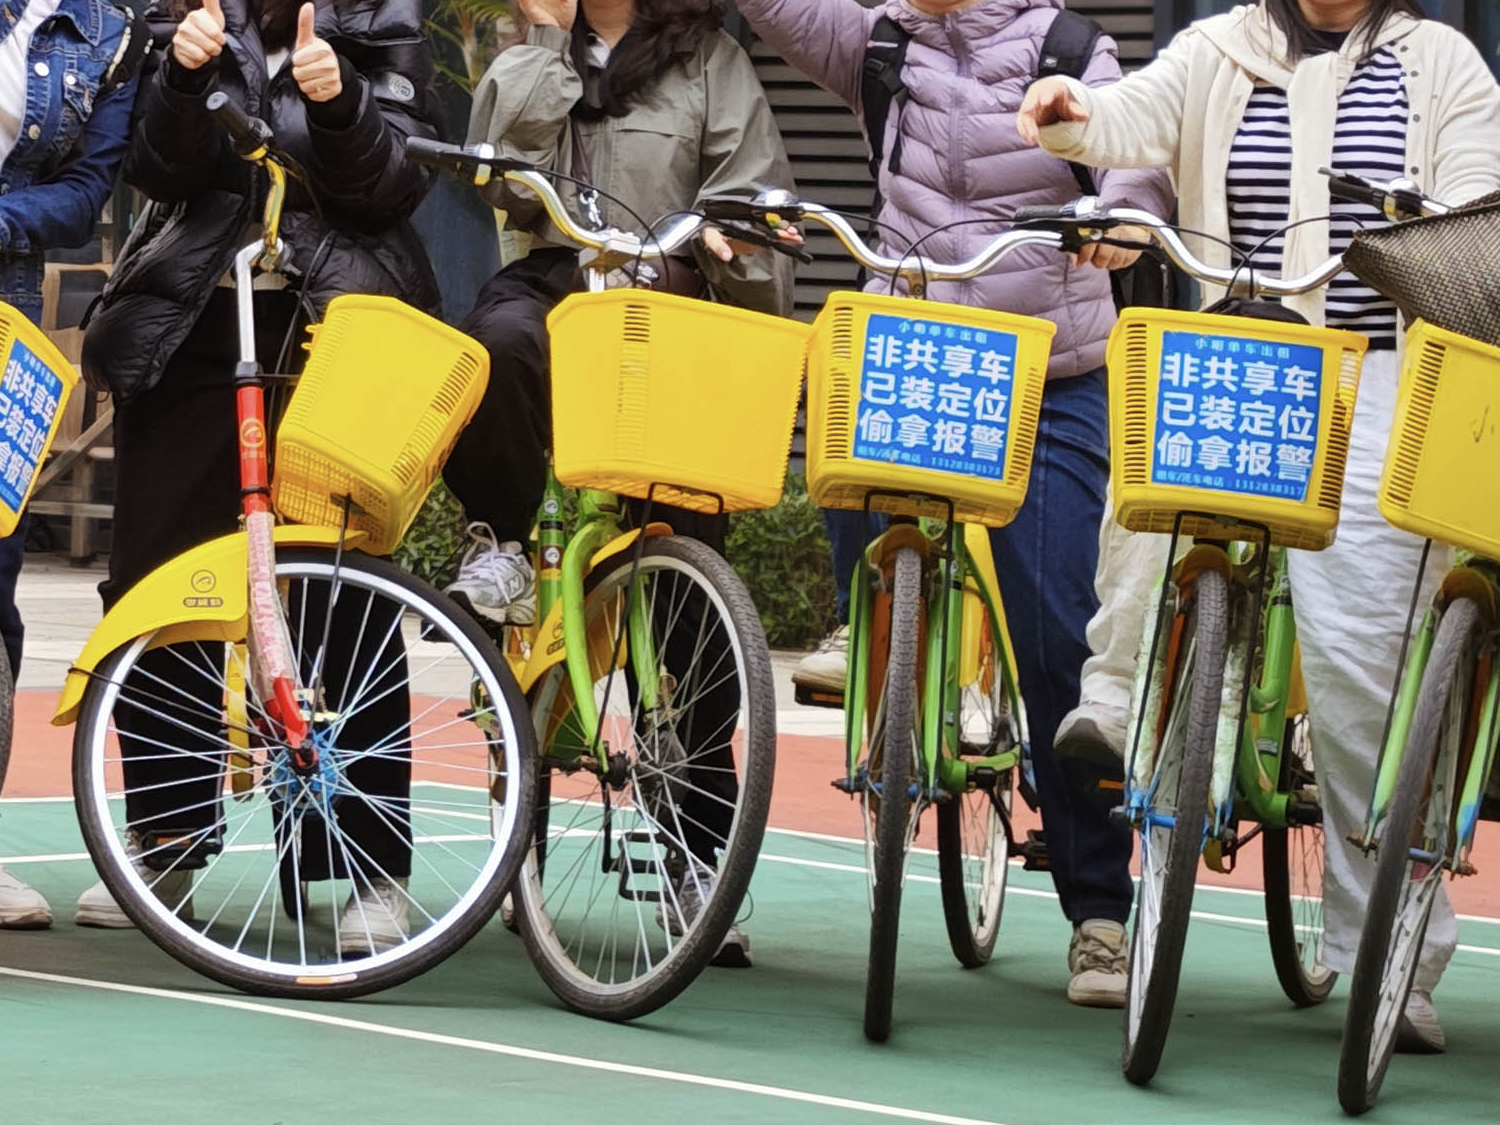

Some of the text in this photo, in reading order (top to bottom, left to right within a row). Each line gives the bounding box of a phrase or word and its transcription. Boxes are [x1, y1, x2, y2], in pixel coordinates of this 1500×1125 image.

[866, 334, 1012, 385] 非共享车
[1162, 352, 1318, 402] 非共享车
[3, 359, 57, 427] 非共享车
[863, 371, 1008, 423] 已装定位
[1161, 391, 1316, 442] 已装定位
[859, 408, 1005, 462] 偷拿报警
[1156, 429, 1313, 483] 偷拿报警
